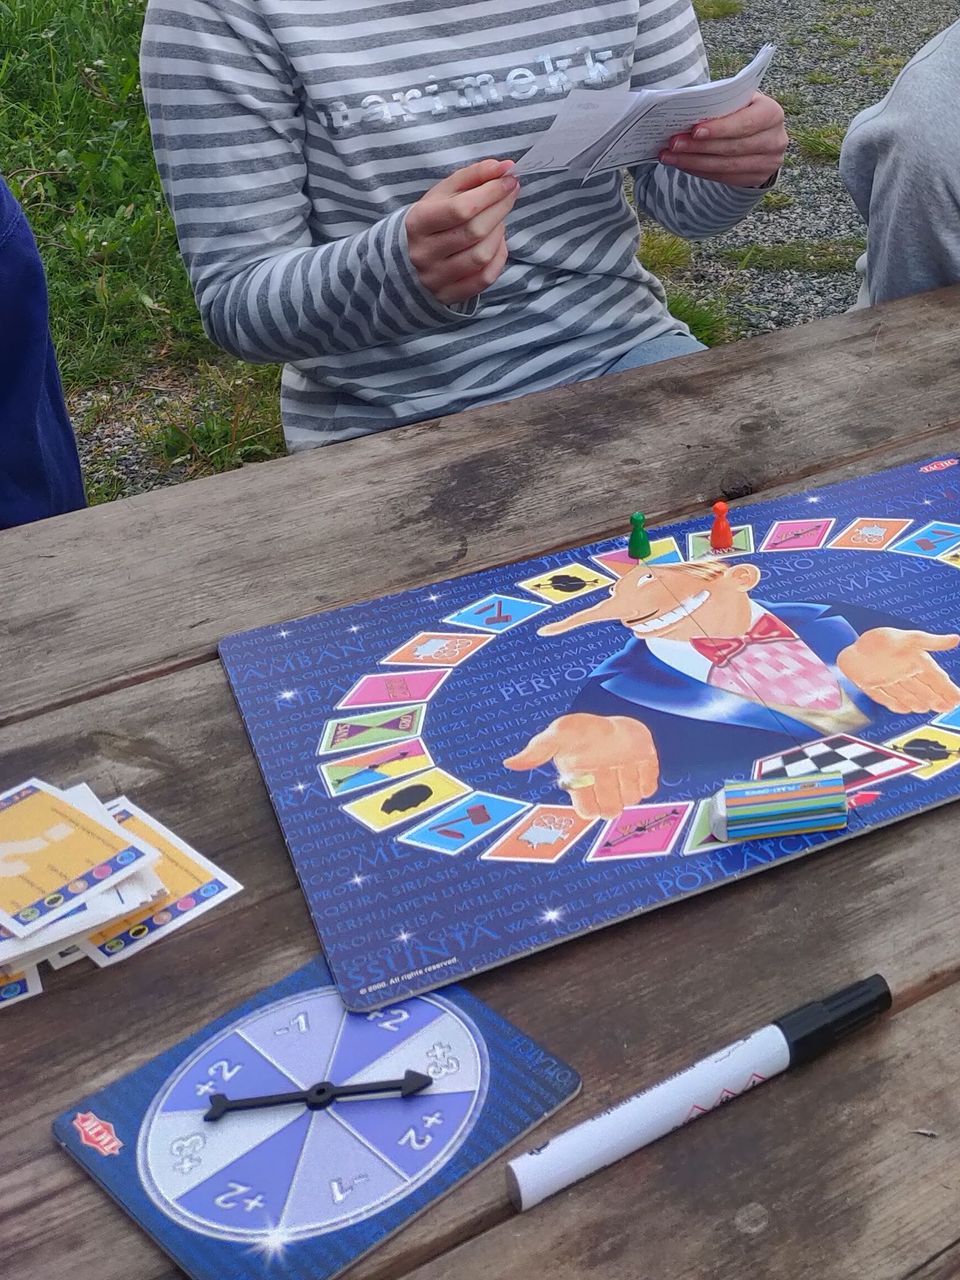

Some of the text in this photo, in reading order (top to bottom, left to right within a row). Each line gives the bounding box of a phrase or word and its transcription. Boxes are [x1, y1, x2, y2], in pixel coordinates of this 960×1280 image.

[422, 954, 459, 974] reserved.
[274, 1010, 311, 1038] -1
[195, 1058, 245, 1099] +2
[398, 1109, 443, 1151] +2
[171, 1132, 207, 1176] +3
[213, 1180, 266, 1213] +2
[331, 1174, 370, 1205] -1
